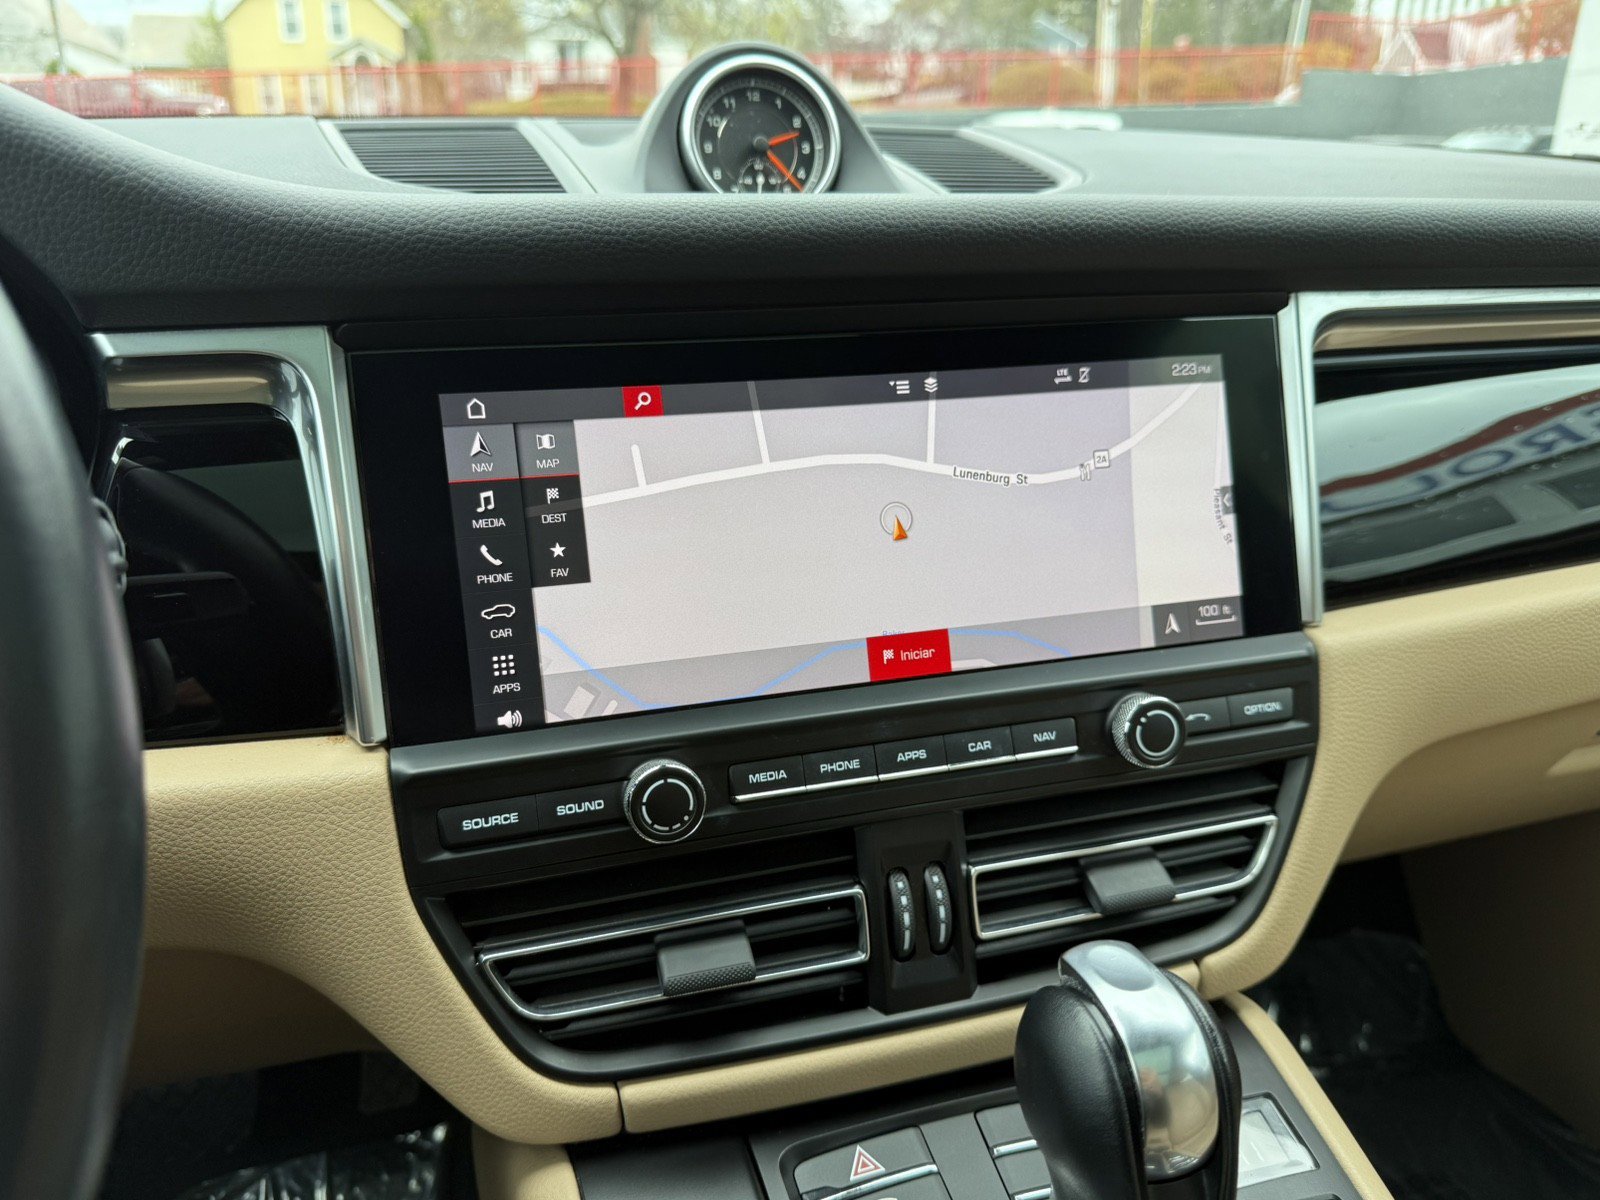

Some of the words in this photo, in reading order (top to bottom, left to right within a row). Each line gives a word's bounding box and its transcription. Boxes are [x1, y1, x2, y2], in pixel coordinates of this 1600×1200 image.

[747, 90, 761, 102] 12
[724, 98, 736, 110] 11
[708, 115, 721, 127] 10
[802, 141, 810, 154] 3
[798, 167, 806, 180] 4
[1056, 368, 1069, 377] LTE
[536, 458, 560, 469] MAP
[1096, 455, 1107, 464] 2A
[471, 462, 494, 473] NAV
[952, 467, 1010, 487] Lunenburg
[1016, 474, 1028, 486] St
[472, 517, 506, 529] MEDIA
[541, 512, 567, 524] DEST
[477, 572, 514, 584] PHONE
[550, 568, 569, 578] FAV
[1198, 605, 1218, 617] 100
[490, 628, 513, 639] CAR
[900, 648, 935, 661] Iniciar
[493, 682, 521, 694] APPS
[1243, 701, 1282, 716] OPTION
[1032, 730, 1057, 744] NAV
[968, 740, 992, 753] CAR
[896, 749, 928, 763] APPS
[819, 758, 861, 774] PHONE
[748, 769, 788, 784] MEDIA
[556, 799, 605, 816] SOUND
[461, 812, 520, 831] SOURCE
